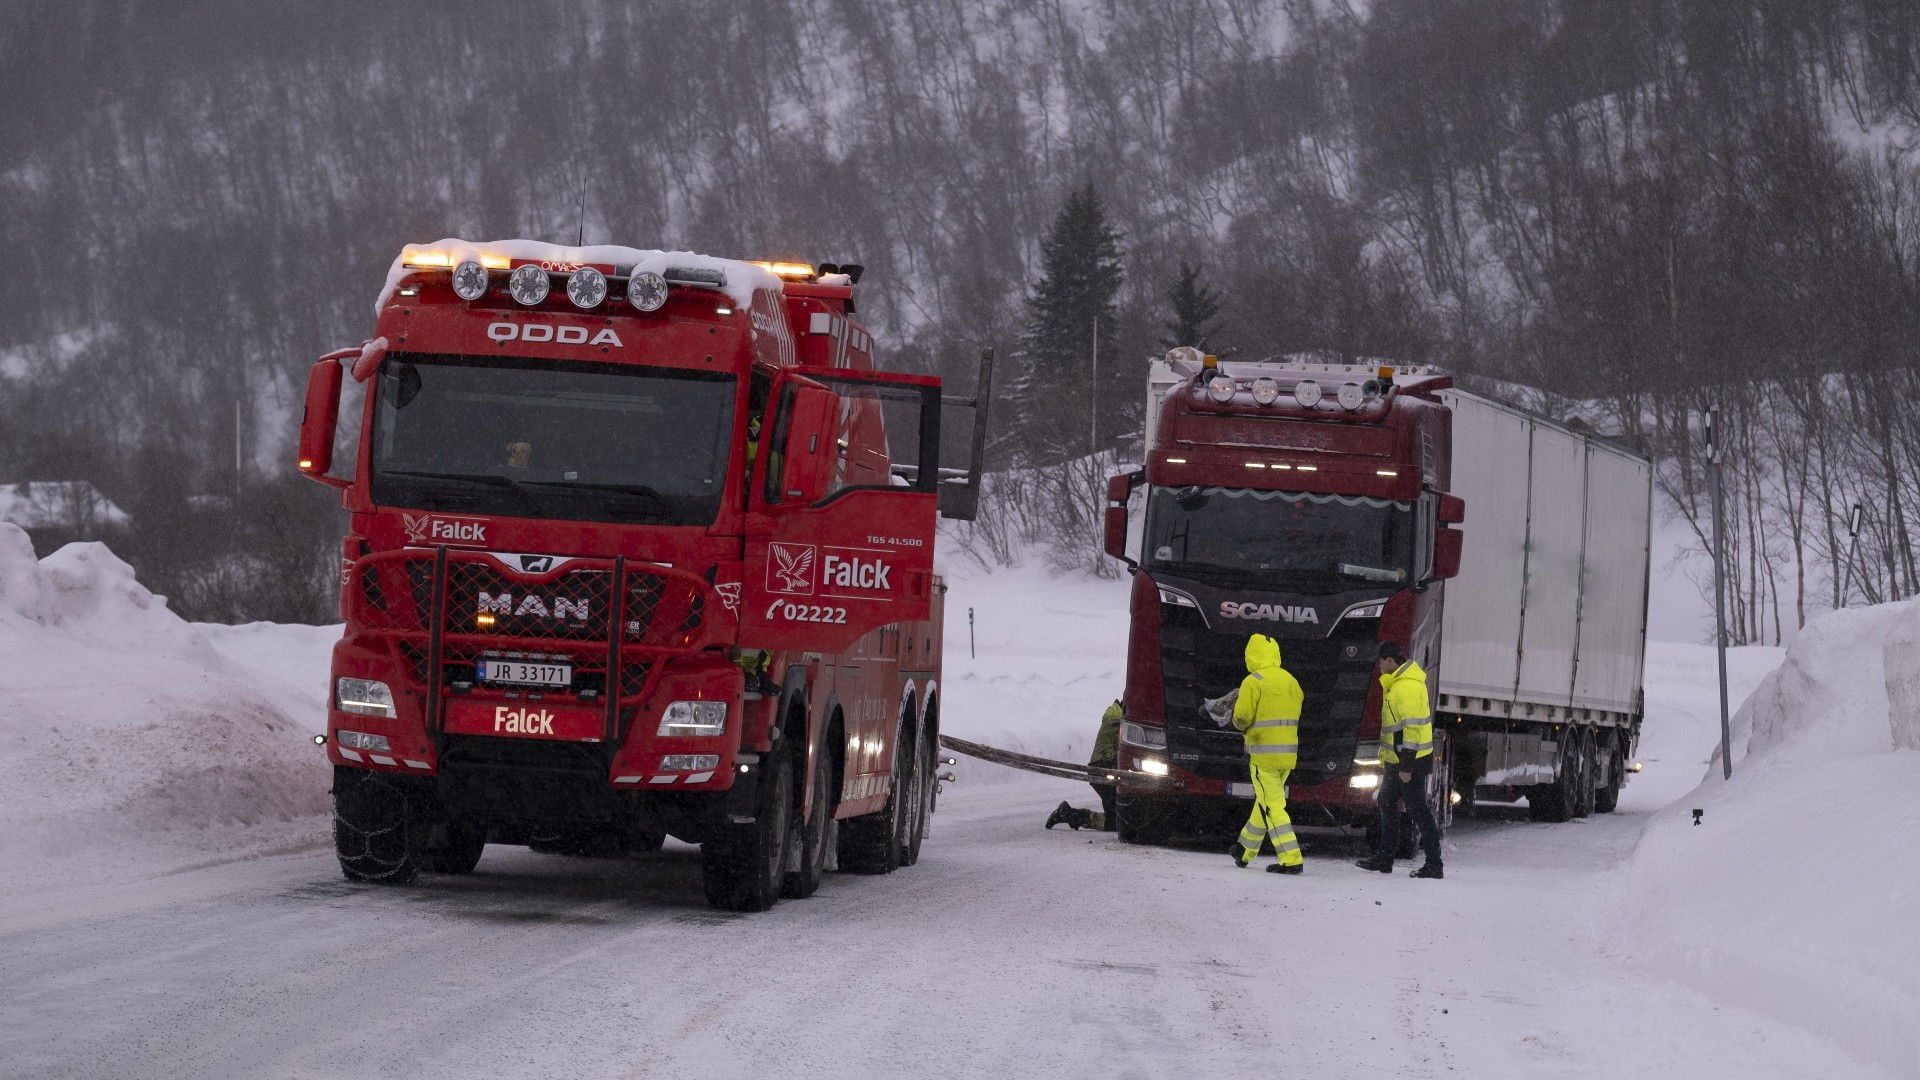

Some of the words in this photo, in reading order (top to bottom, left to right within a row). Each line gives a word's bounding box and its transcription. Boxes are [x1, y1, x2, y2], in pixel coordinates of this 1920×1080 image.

[431, 520, 486, 541] Falck
[867, 536, 886, 544] TGS
[888, 537, 923, 547] 41.500
[823, 555, 891, 590] Falck
[478, 591, 590, 620] MAN
[784, 603, 847, 624] 02222
[1219, 601, 1320, 624] SCANIA
[494, 664, 511, 679] JR
[519, 665, 564, 682] 33171
[494, 706, 555, 735] Falck
